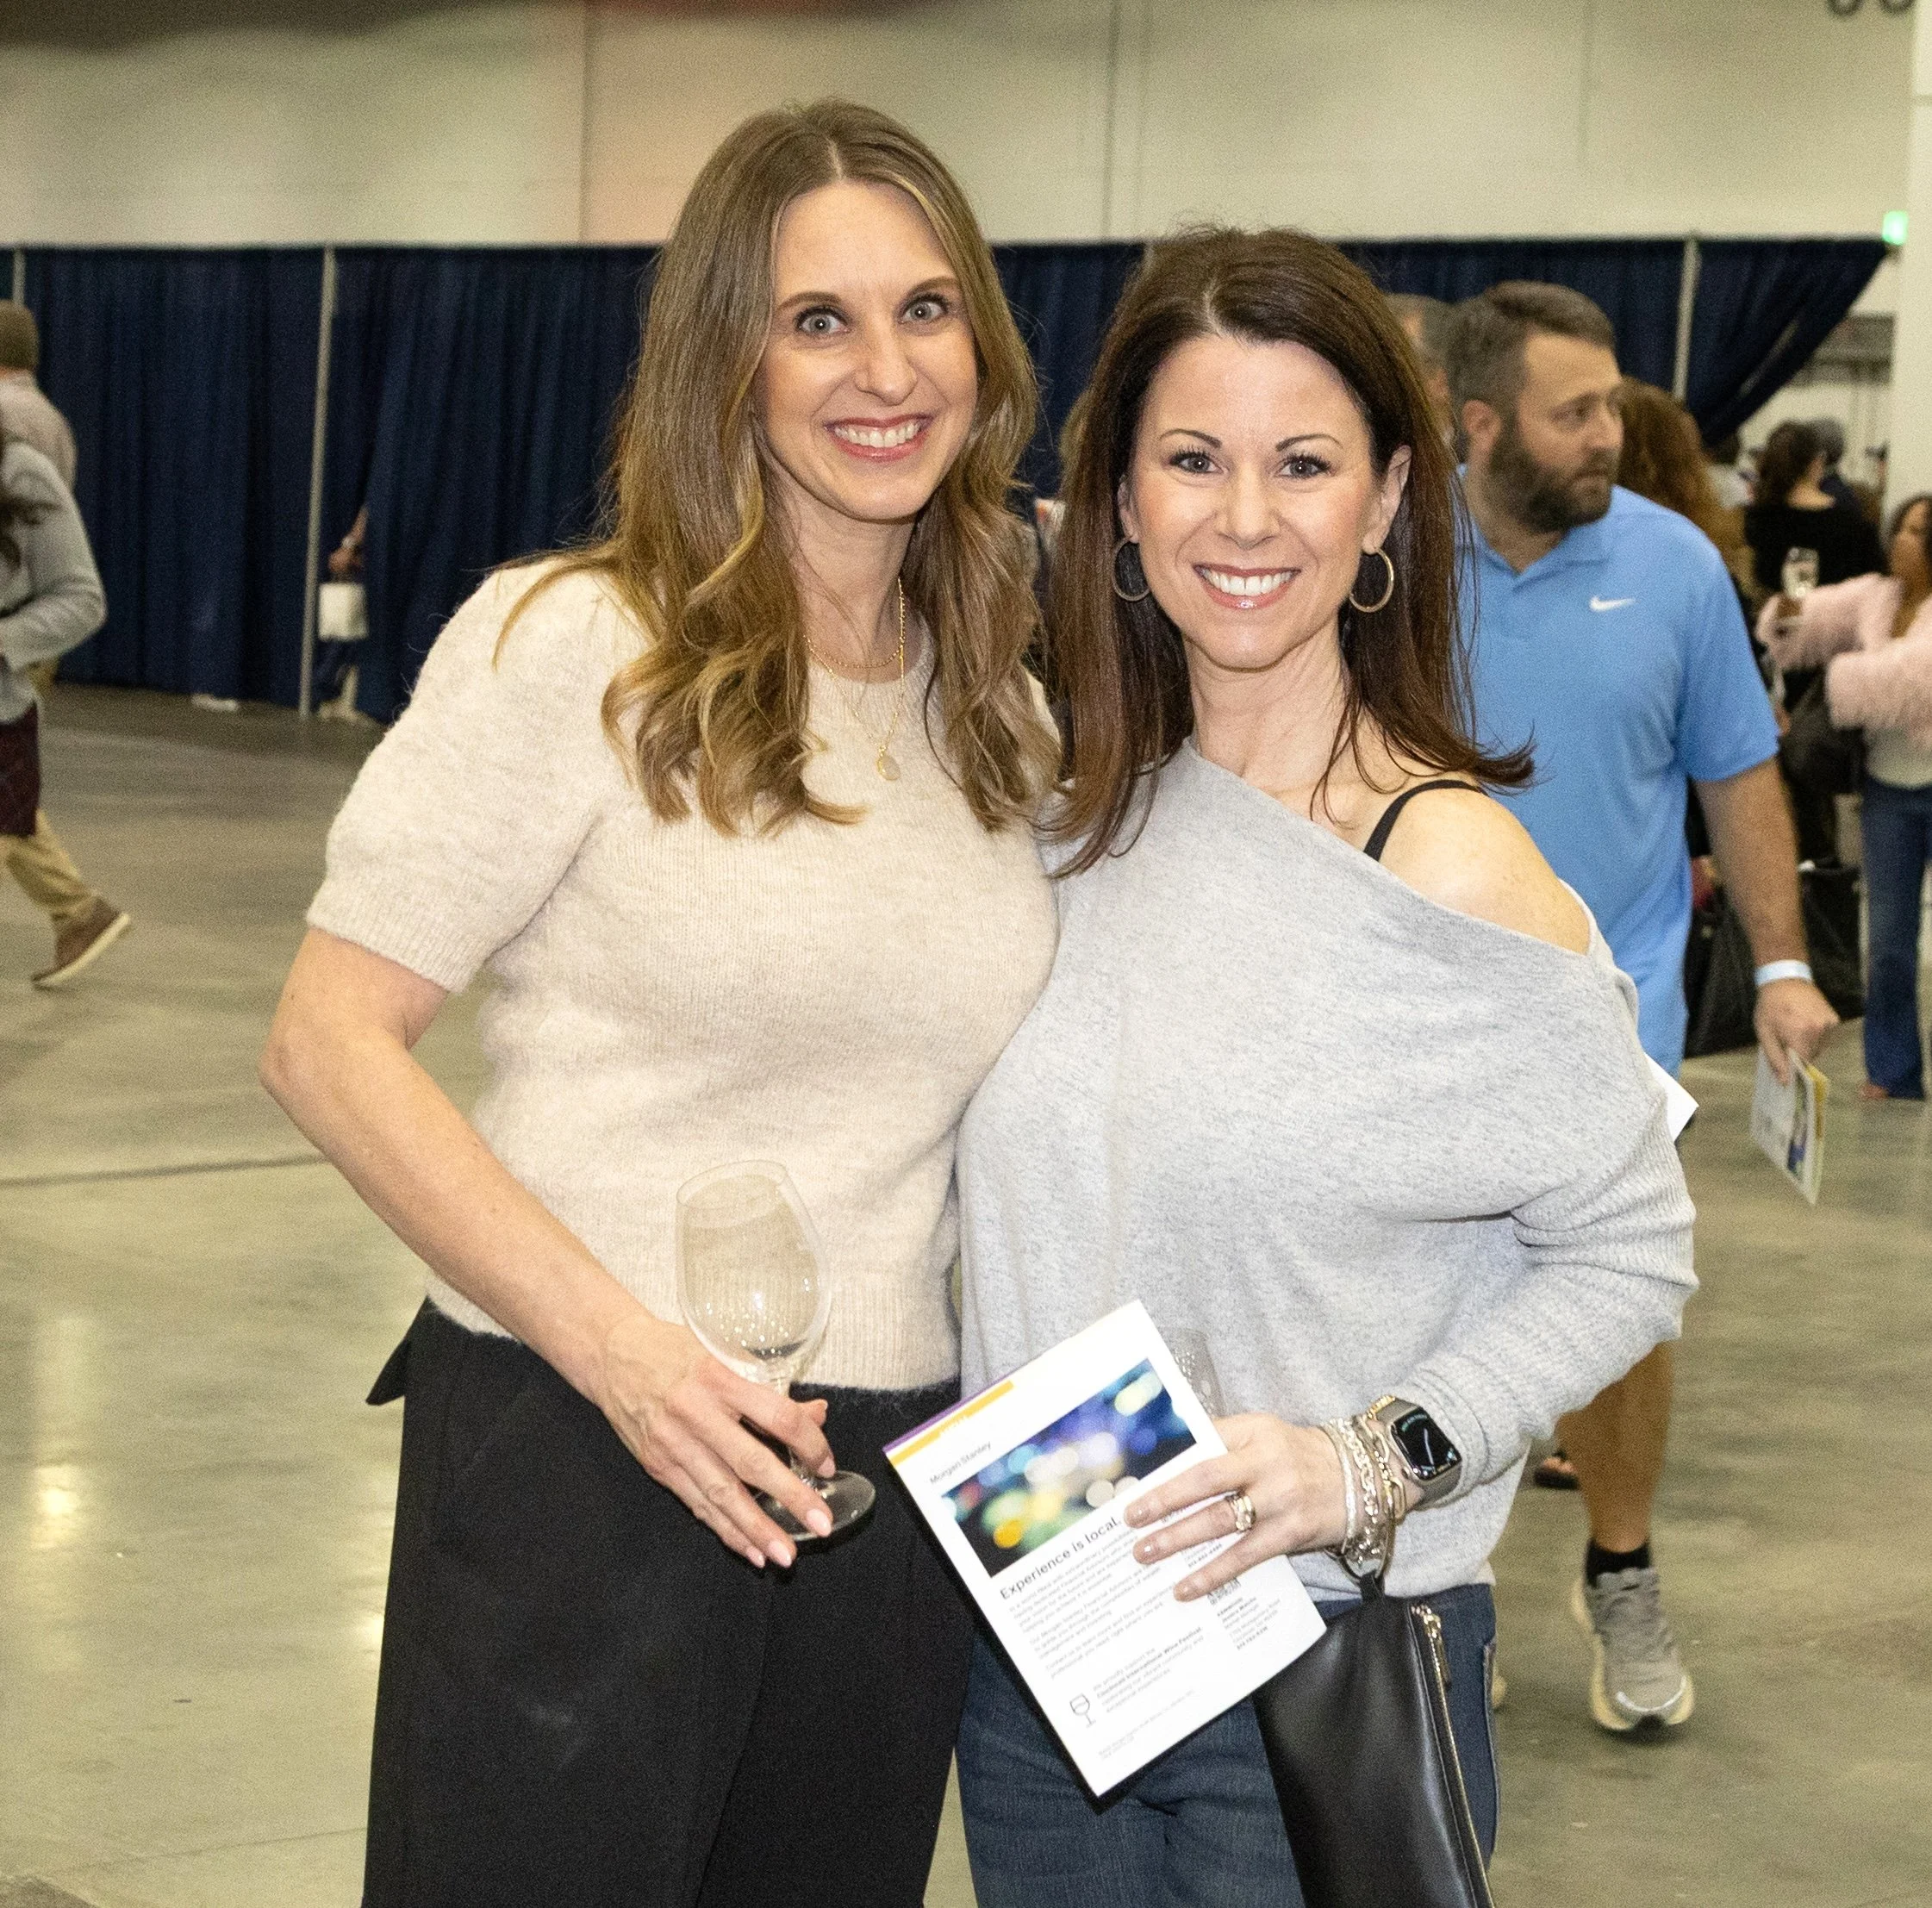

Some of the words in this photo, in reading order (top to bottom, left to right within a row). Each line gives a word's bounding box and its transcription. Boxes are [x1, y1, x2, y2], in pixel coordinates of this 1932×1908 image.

[929, 1461, 961, 1484] Morgan
[1000, 1549, 1070, 1599] Experience
[1071, 1540, 1084, 1552] is
[1084, 1516, 1121, 1543] local.
